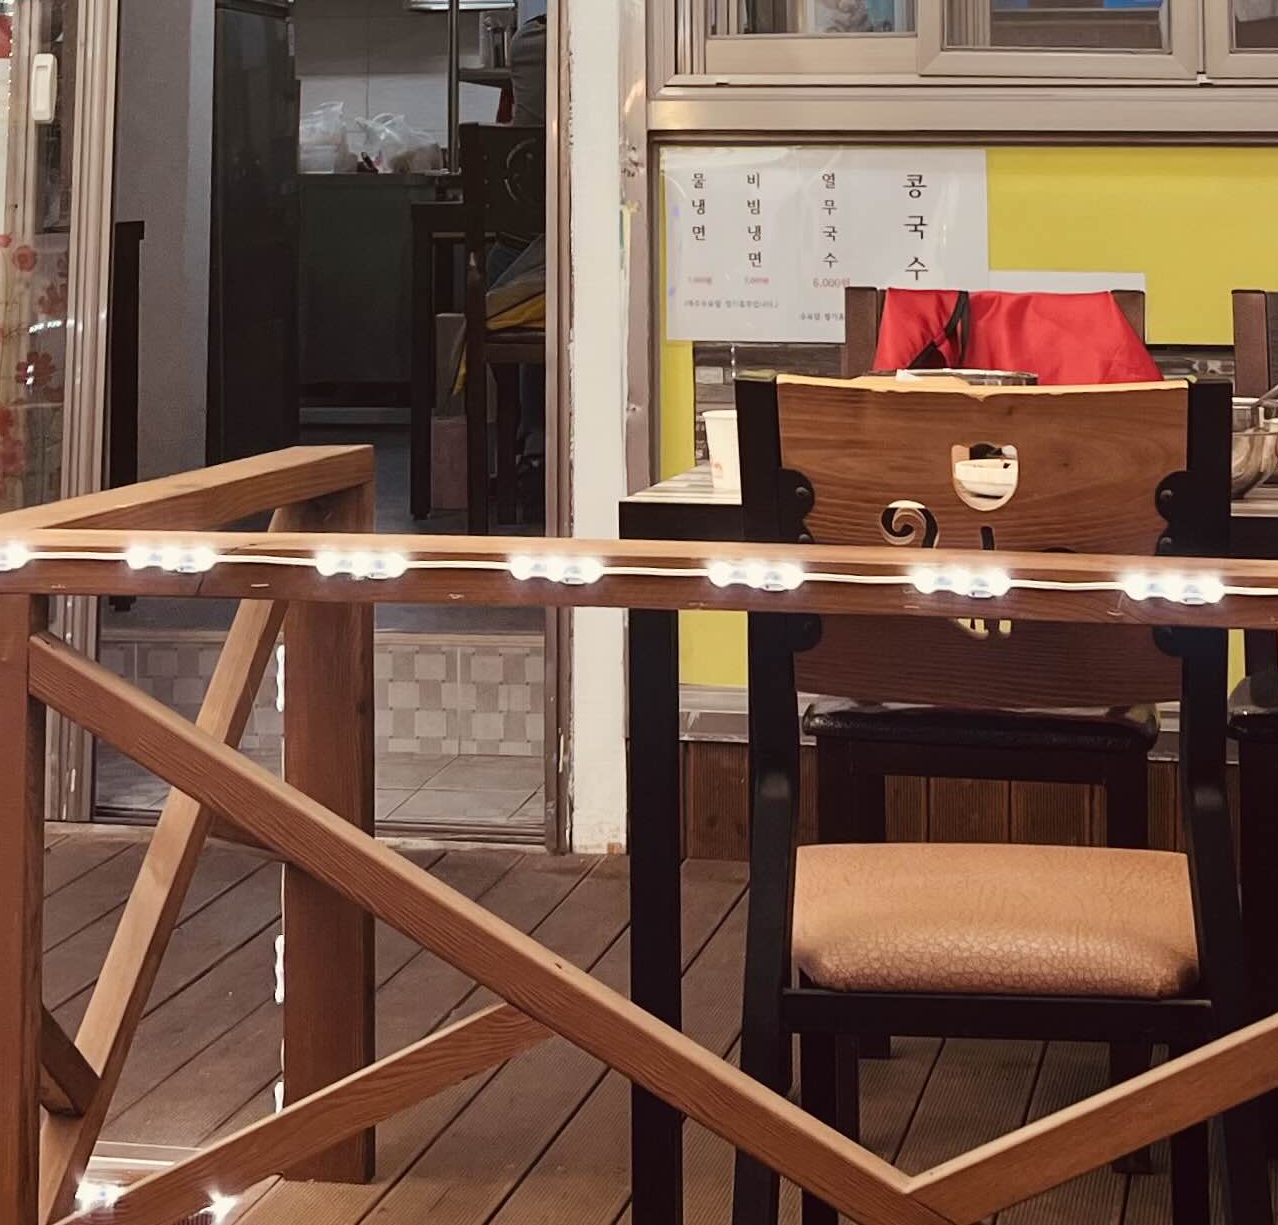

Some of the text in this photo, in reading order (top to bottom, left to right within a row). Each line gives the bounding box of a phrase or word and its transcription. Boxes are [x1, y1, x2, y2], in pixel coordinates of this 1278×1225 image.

[691, 172, 706, 242] 물냉면
[746, 172, 762, 268] 비빔냉면
[822, 172, 839, 268] 열무국수
[902, 173, 929, 281] 콩국수
